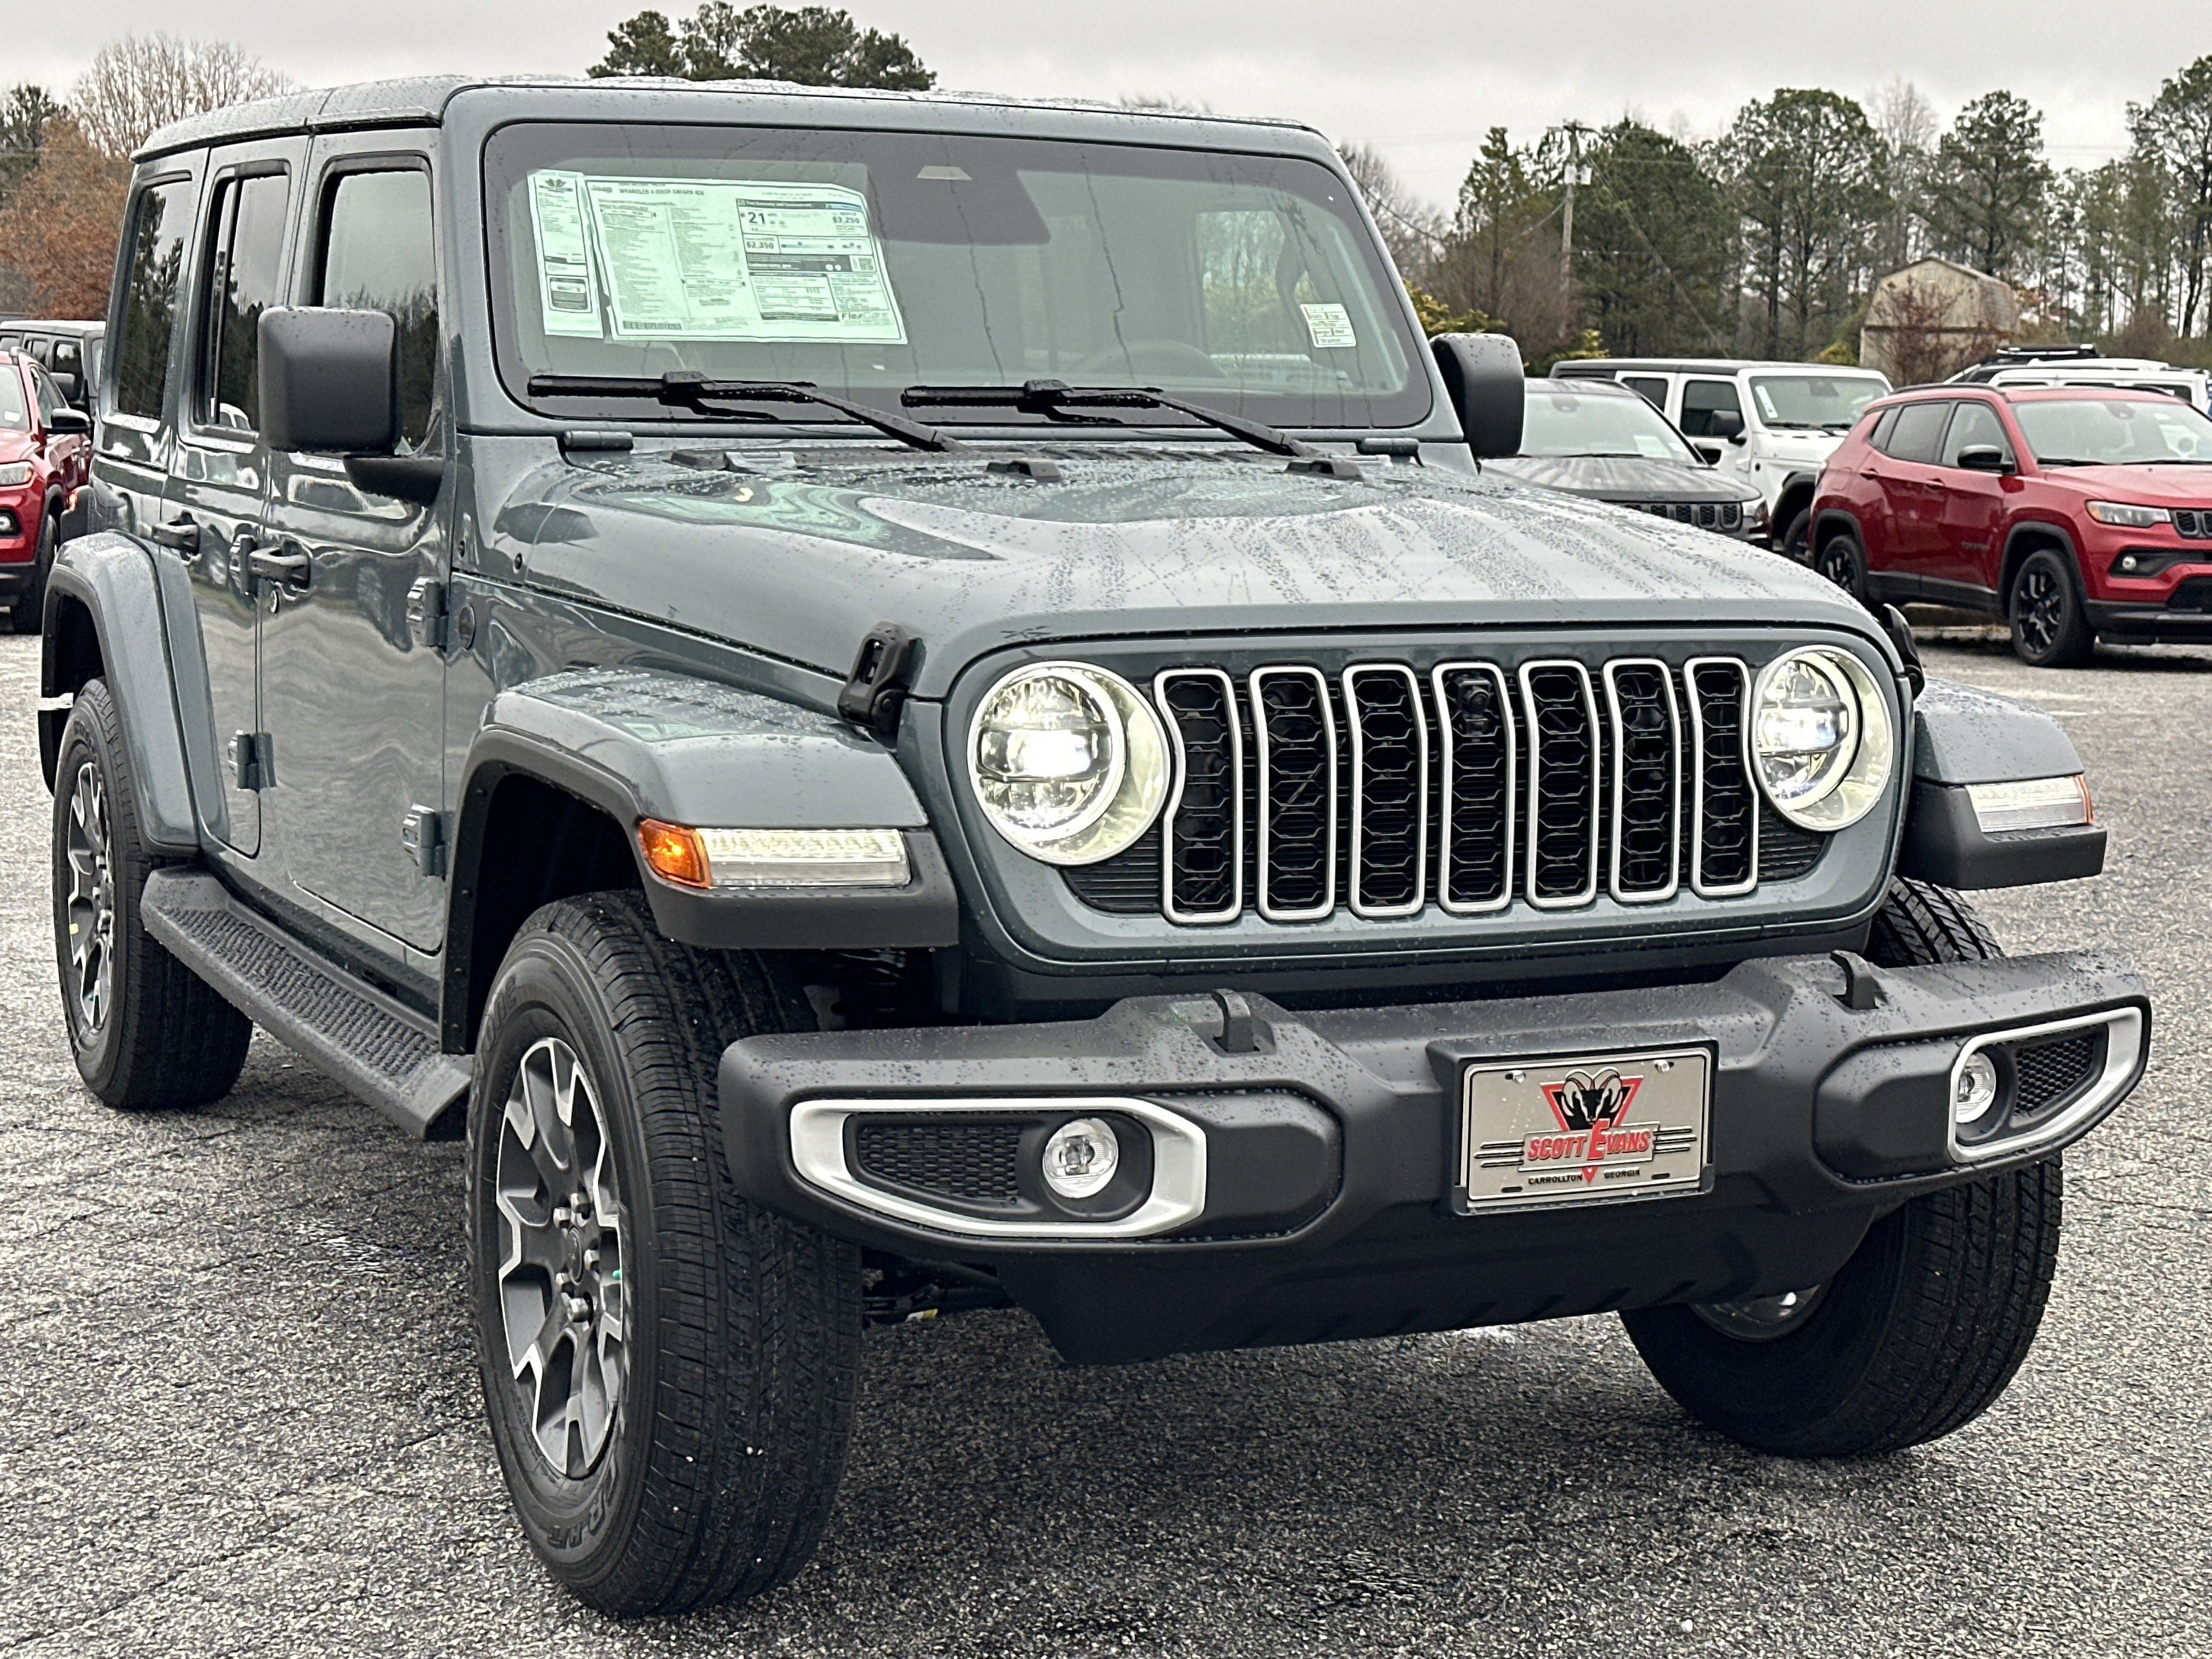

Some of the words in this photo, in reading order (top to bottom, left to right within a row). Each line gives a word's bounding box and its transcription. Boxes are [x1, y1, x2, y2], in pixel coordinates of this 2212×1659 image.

[747, 211, 766, 225] 21
[1528, 1133, 1588, 1160] SCOTT
[1588, 1118, 1650, 1161] EVANS
[1528, 1171, 1583, 1185] CARROLLTON
[1603, 1166, 1640, 1179] GEORGIA
